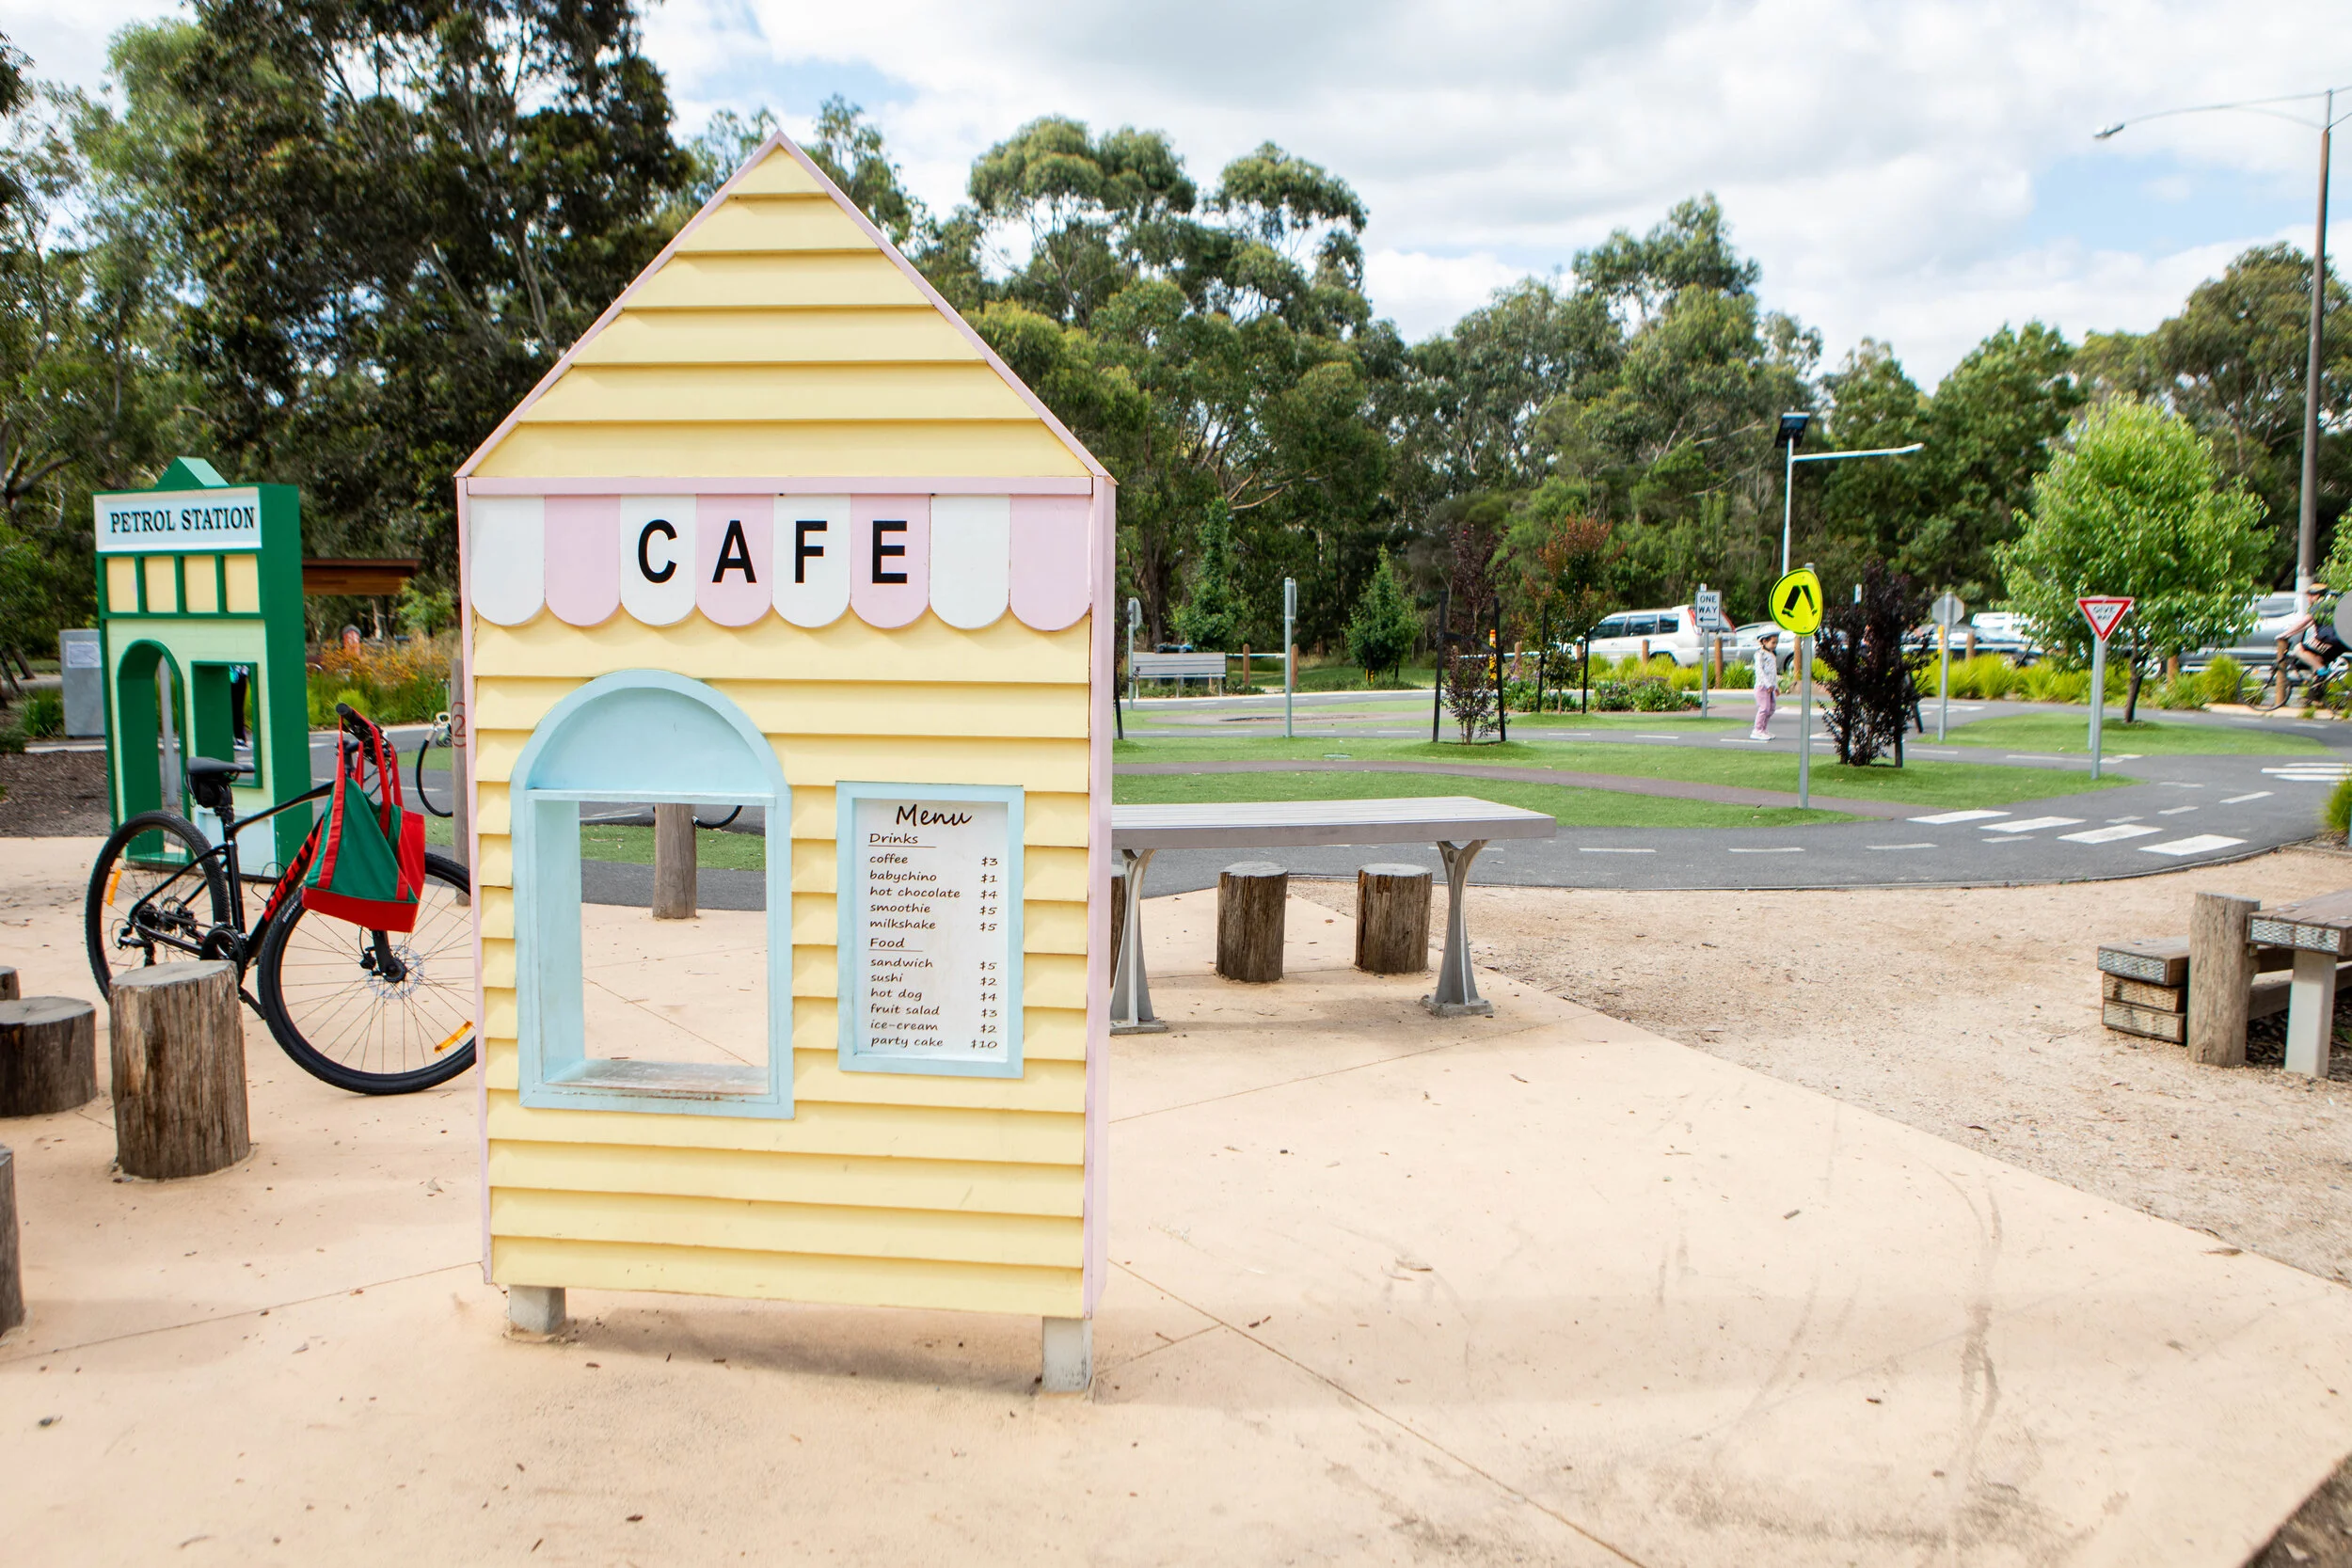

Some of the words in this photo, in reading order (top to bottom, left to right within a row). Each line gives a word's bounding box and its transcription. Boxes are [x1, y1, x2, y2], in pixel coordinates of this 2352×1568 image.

[110, 510, 176, 533] PETROL
[181, 506, 255, 531] STATION
[638, 518, 908, 584] CAFE
[1700, 594, 1717, 603] ONE
[453, 714, 466, 737] 2
[896, 803, 973, 827] Menu
[869, 832, 918, 844] Drinks
[869, 853, 909, 863] coffee
[980, 857, 998, 866] $3
[869, 870, 937, 883] babychino
[980, 874, 997, 883] $1
[869, 886, 893, 896] hot
[898, 887, 961, 898] chocolate
[980, 890, 997, 899] $4
[870, 903, 930, 913] smoothie
[979, 906, 997, 915] $5
[869, 919, 936, 929] milkshake
[979, 922, 997, 931] $5
[870, 937, 905, 948] Food
[870, 958, 933, 968] sandwich
[979, 961, 996, 971] $5
[870, 974, 903, 983] sushi
[980, 976, 997, 986] $2
[870, 988, 892, 997] hot
[898, 989, 922, 1001] dog
[980, 992, 997, 1002] $4
[870, 1004, 900, 1014] fruit
[906, 1006, 940, 1016] salad
[980, 1008, 997, 1018] $3
[870, 1020, 938, 1031] ice-cream
[980, 1023, 997, 1034] $2
[871, 1037, 909, 1048] party
[914, 1037, 944, 1047] cake
[970, 1039, 998, 1049] $10
